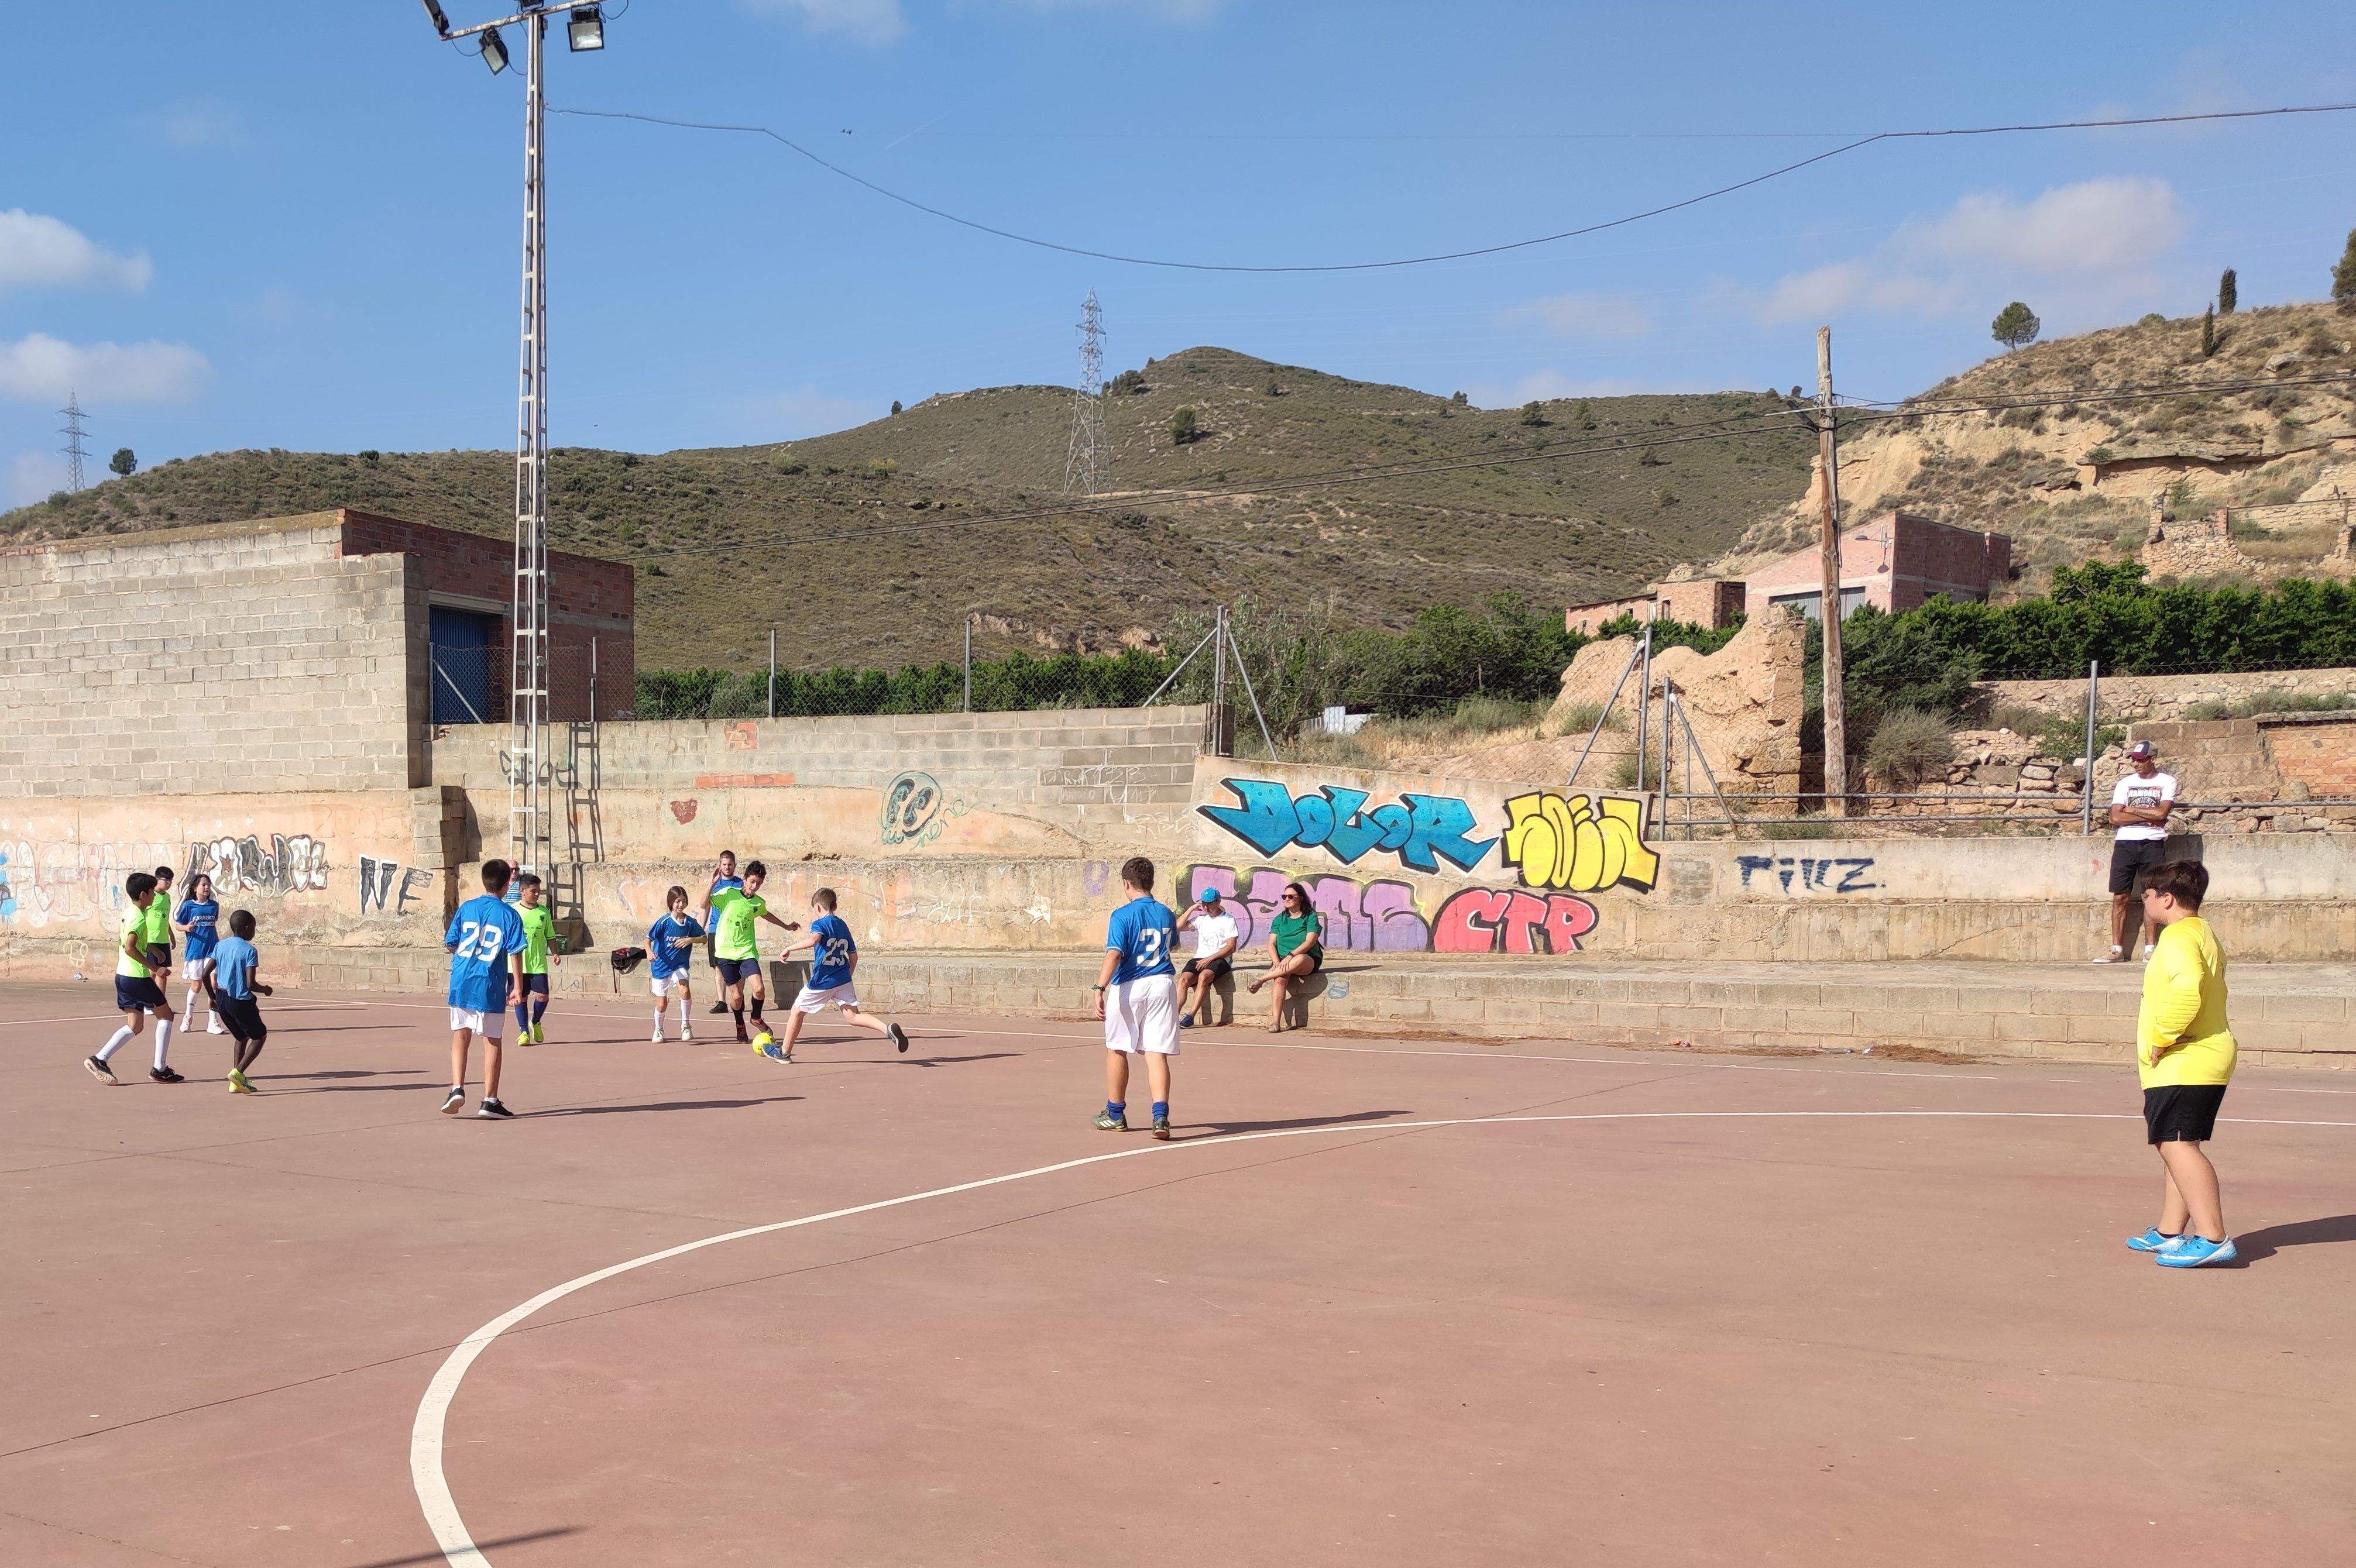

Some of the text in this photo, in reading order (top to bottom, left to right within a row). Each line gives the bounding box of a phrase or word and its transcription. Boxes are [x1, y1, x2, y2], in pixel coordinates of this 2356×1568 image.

[1431, 886, 1600, 954] CTP
[457, 921, 502, 962] 29
[822, 937, 849, 967] 23
